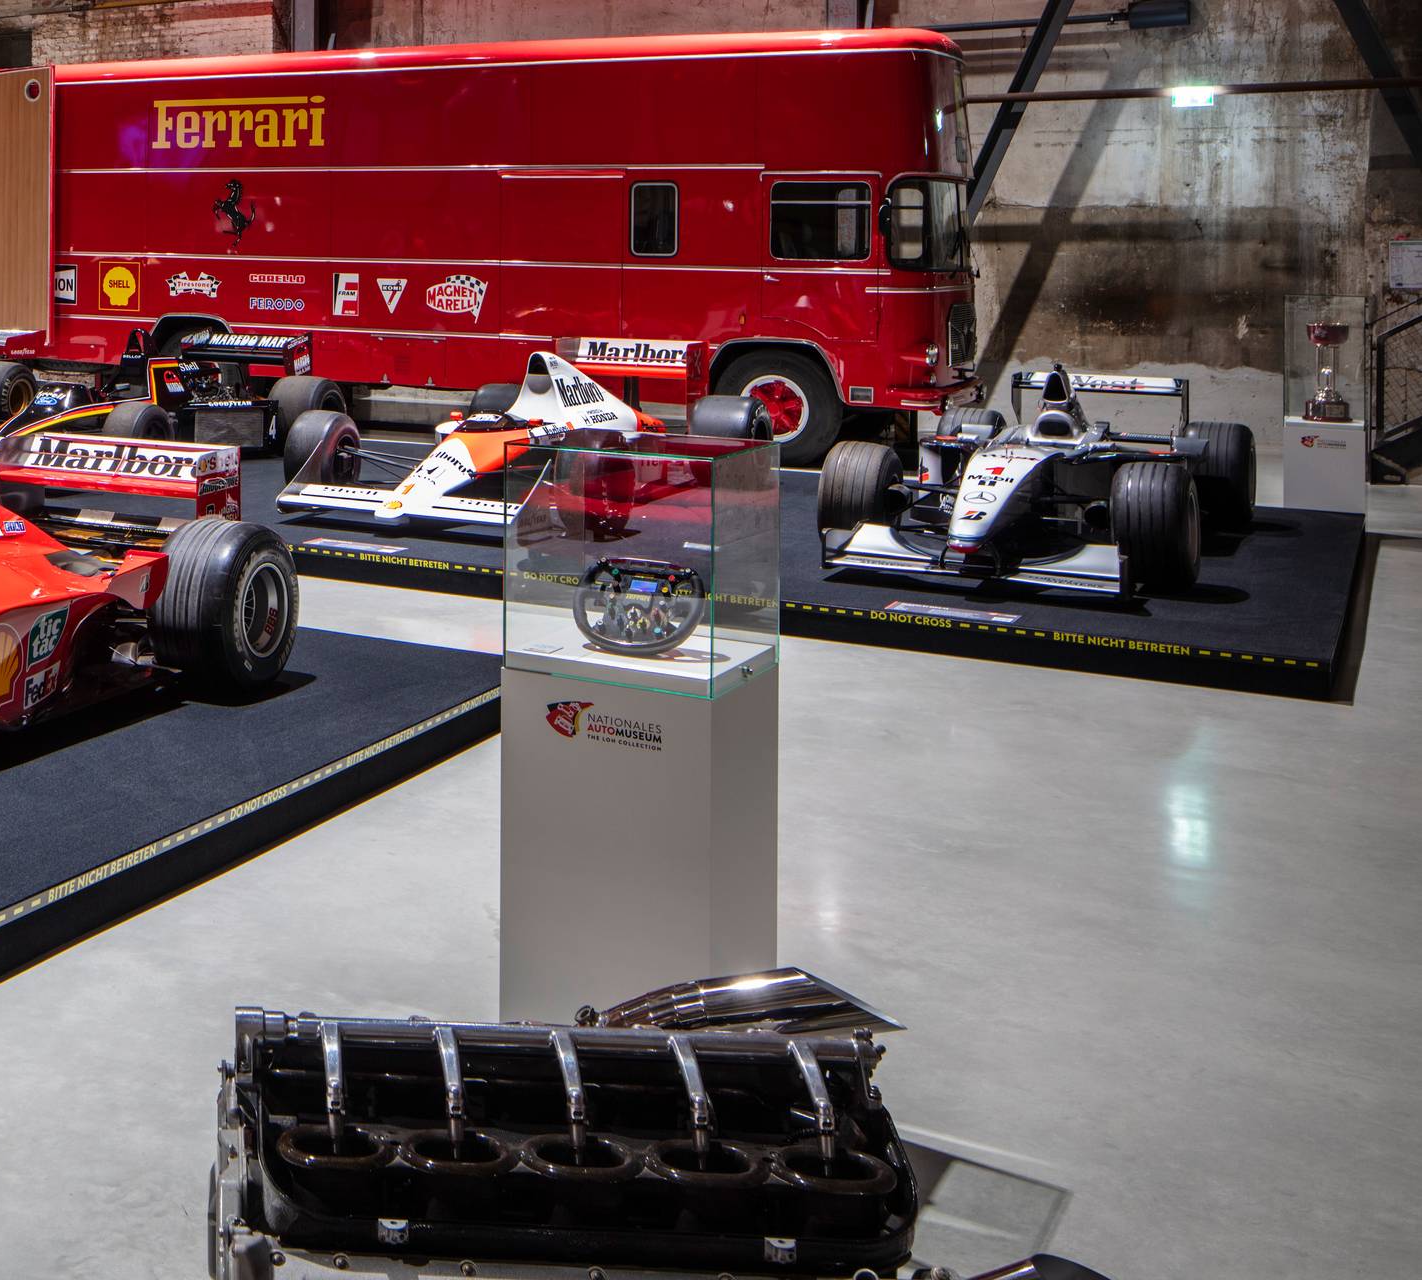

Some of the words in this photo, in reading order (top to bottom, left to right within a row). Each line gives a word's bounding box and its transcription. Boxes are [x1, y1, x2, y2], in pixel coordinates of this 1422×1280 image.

[152, 95, 326, 149] Ferrari
[109, 279, 130, 289] SHELL
[249, 273, 305, 284] CARELLO
[249, 297, 305, 311] FERODO
[209, 334, 257, 348] MAREDO
[179, 361, 199, 372] Shell
[555, 376, 605, 408] Marlboro
[208, 400, 252, 408] GOODYEAR
[591, 411, 619, 425] HONDA
[270, 415, 277, 440] 4
[968, 475, 1014, 483] Mobil
[359, 552, 380, 562] BITTE
[382, 555, 407, 566] NICHT
[409, 557, 450, 570] BETRETEN
[524, 571, 537, 580] DO
[539, 572, 558, 582] NOT
[560, 574, 579, 584] CRO
[730, 594, 778, 608] BETRETEN
[39, 615, 62, 640] tic
[265, 607, 279, 636] BBS
[870, 610, 887, 620] DO
[890, 613, 914, 624] NOT
[915, 615, 952, 628] CROSS
[32, 634, 58, 659] tac
[1053, 631, 1085, 644] BITTE
[1087, 635, 1125, 649] NICHT
[1128, 640, 1190, 655] BETRETEN
[587, 713, 662, 734] NATIONALES
[587, 723, 662, 744] AUTOMUSEUM
[587, 734, 600, 742] THE
[602, 737, 616, 745] LOH
[618, 739, 662, 751] COLLECTION
[346, 750, 364, 767] BITTE
[364, 740, 384, 758] NICHT
[385, 727, 415, 749] BETRETEN
[230, 806, 244, 821] DO
[244, 797, 262, 816] NOT
[262, 784, 288, 805] CROSS
[48, 881, 75, 903] BITTE
[77, 865, 109, 889] NICHT
[110, 843, 158, 874] BETRETEN
